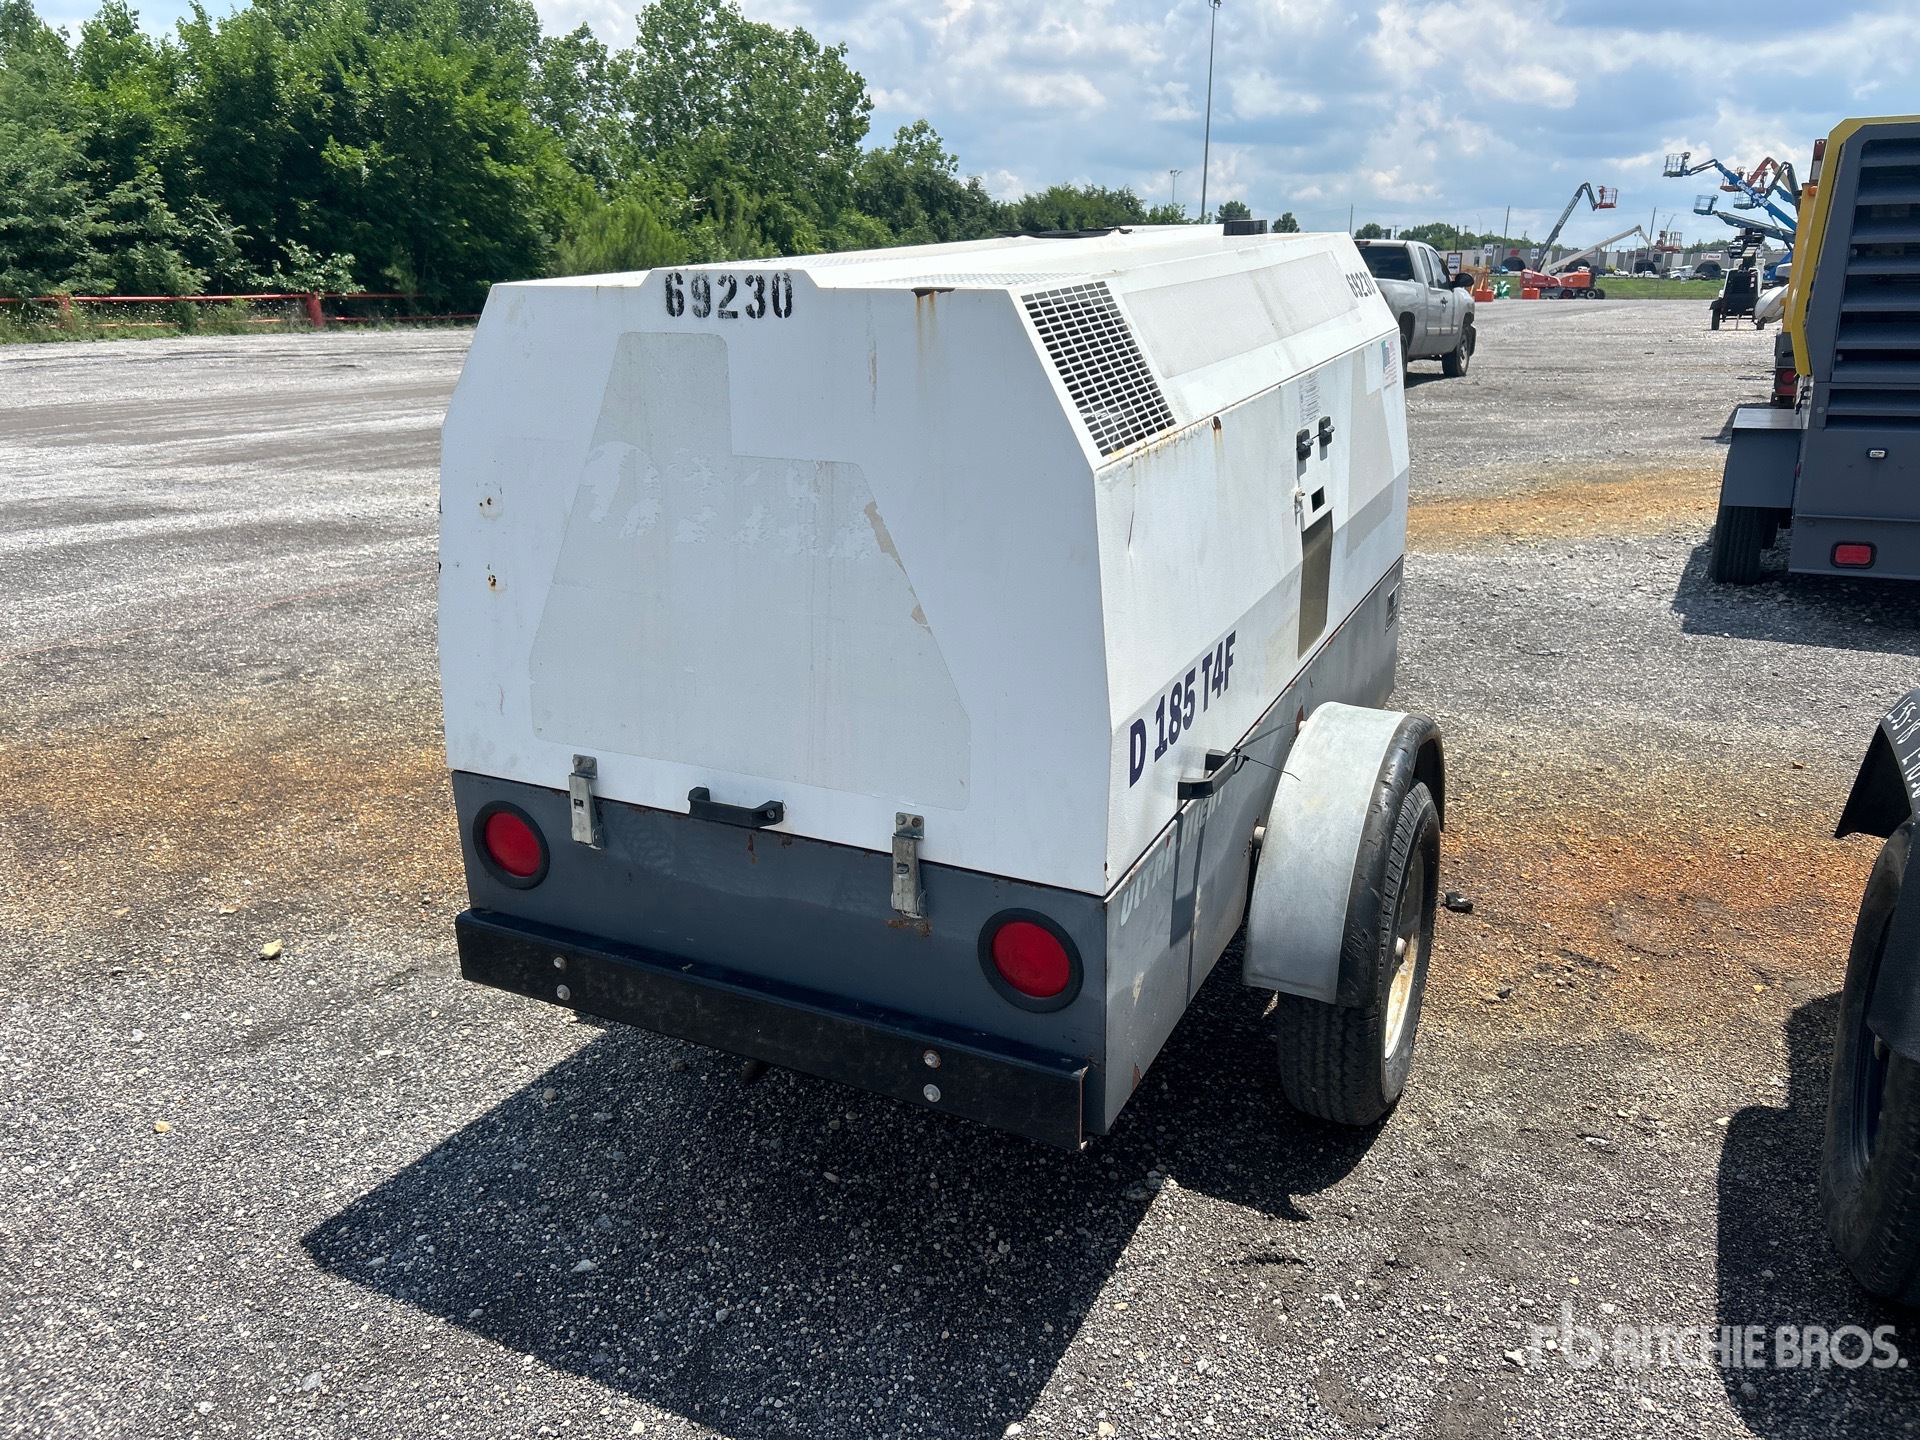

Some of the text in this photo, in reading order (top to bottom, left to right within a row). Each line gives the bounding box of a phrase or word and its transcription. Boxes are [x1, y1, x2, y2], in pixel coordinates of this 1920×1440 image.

[1737, 180, 1753, 195] Genie
[665, 272, 793, 319] 69230
[1345, 271, 1376, 298] 69230
[1129, 630, 1236, 788] D 185 T4F
